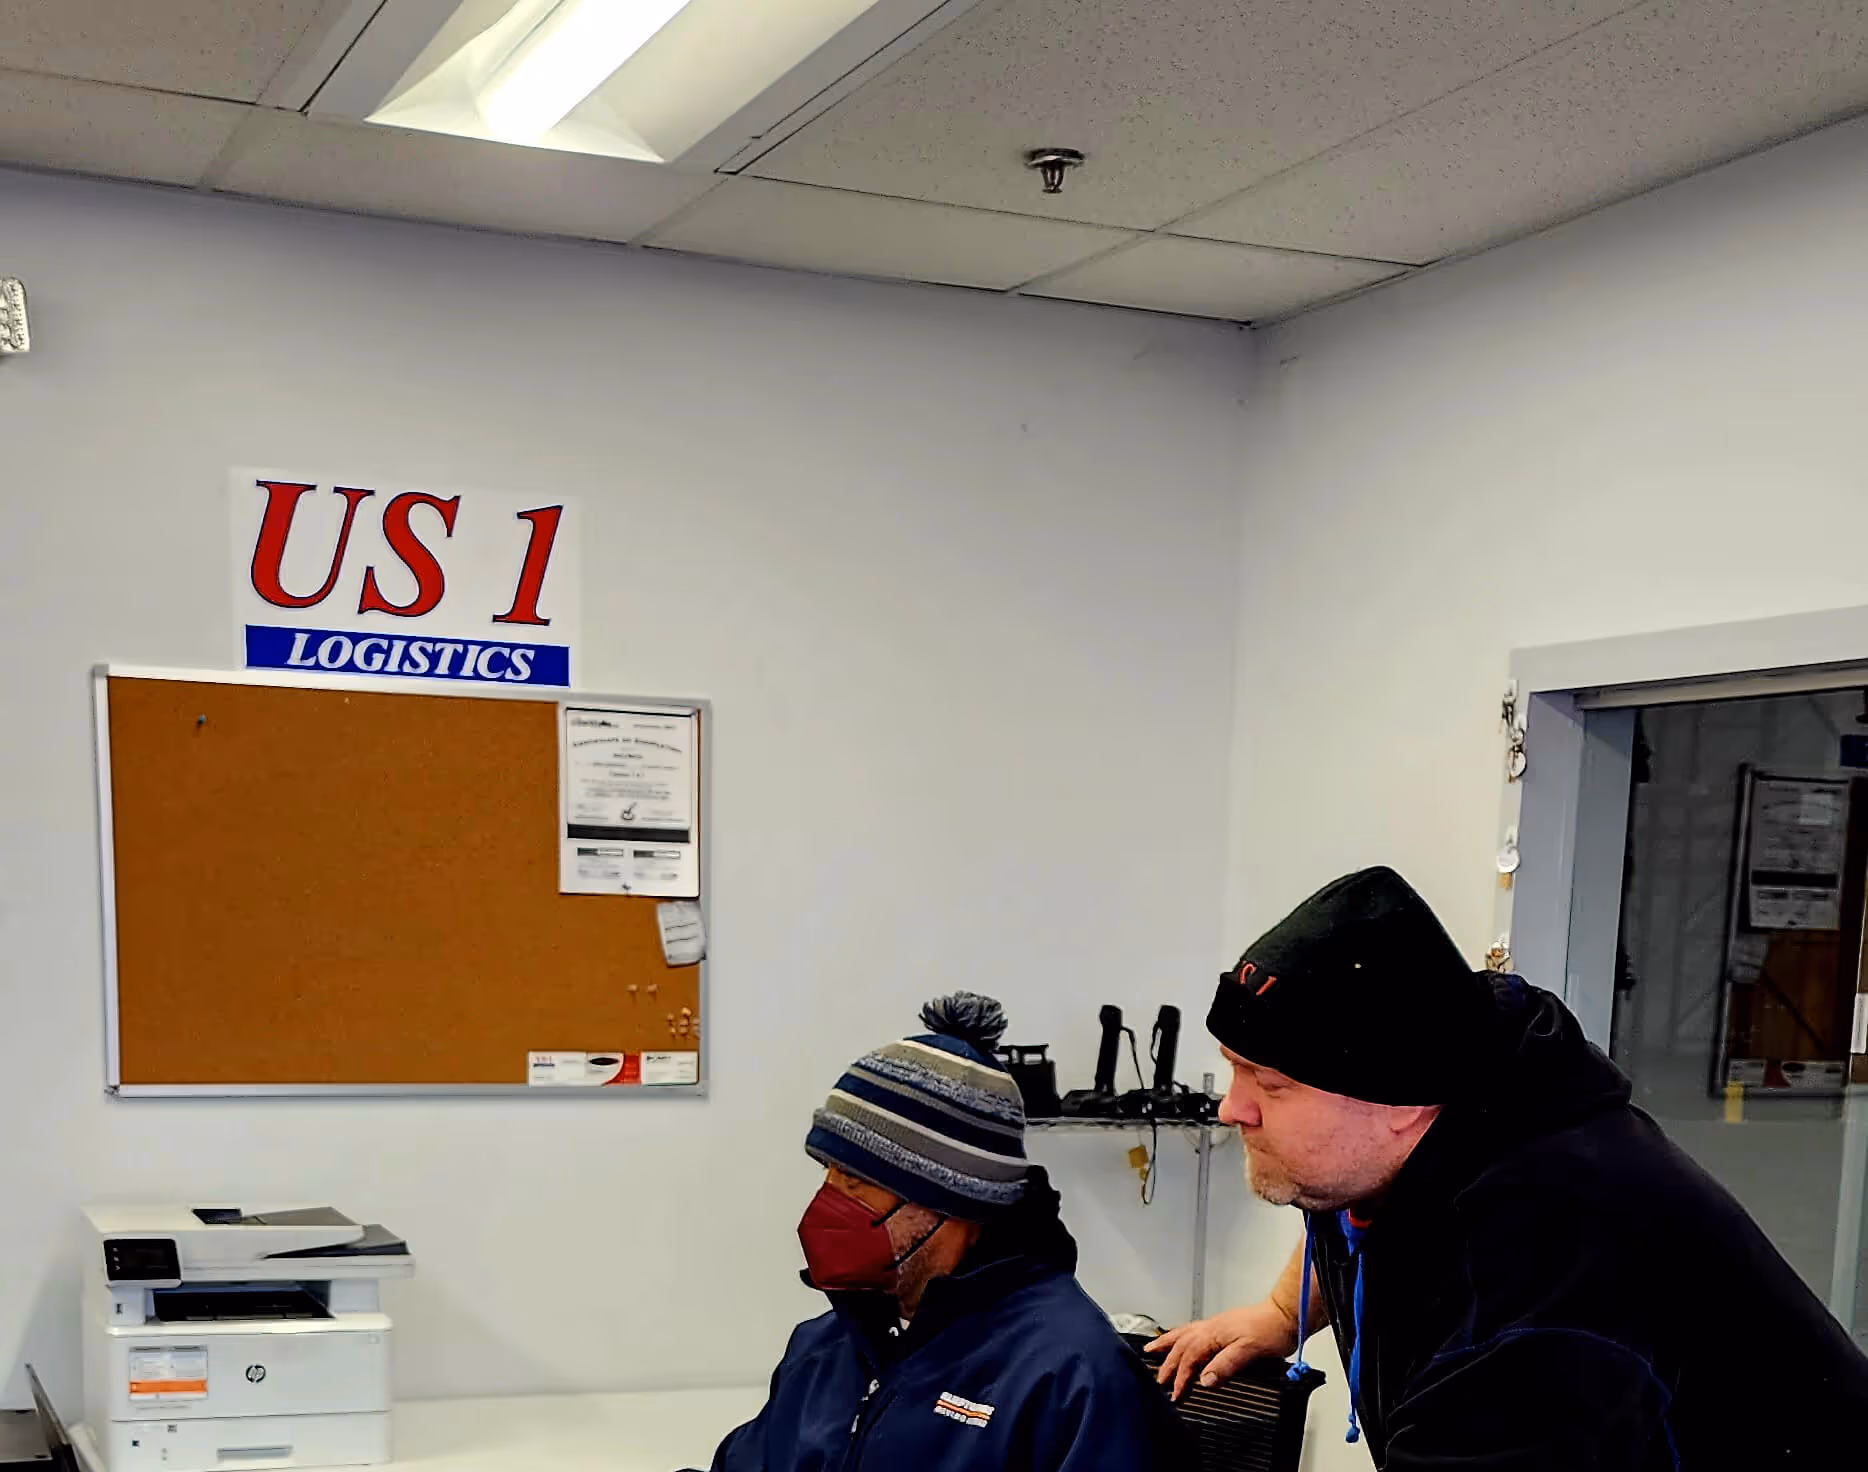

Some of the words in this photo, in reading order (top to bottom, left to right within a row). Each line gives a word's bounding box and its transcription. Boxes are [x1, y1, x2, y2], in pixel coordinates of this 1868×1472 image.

[250, 479, 461, 618] US
[492, 504, 564, 626] 1
[285, 632, 536, 682] LOGISTICS
